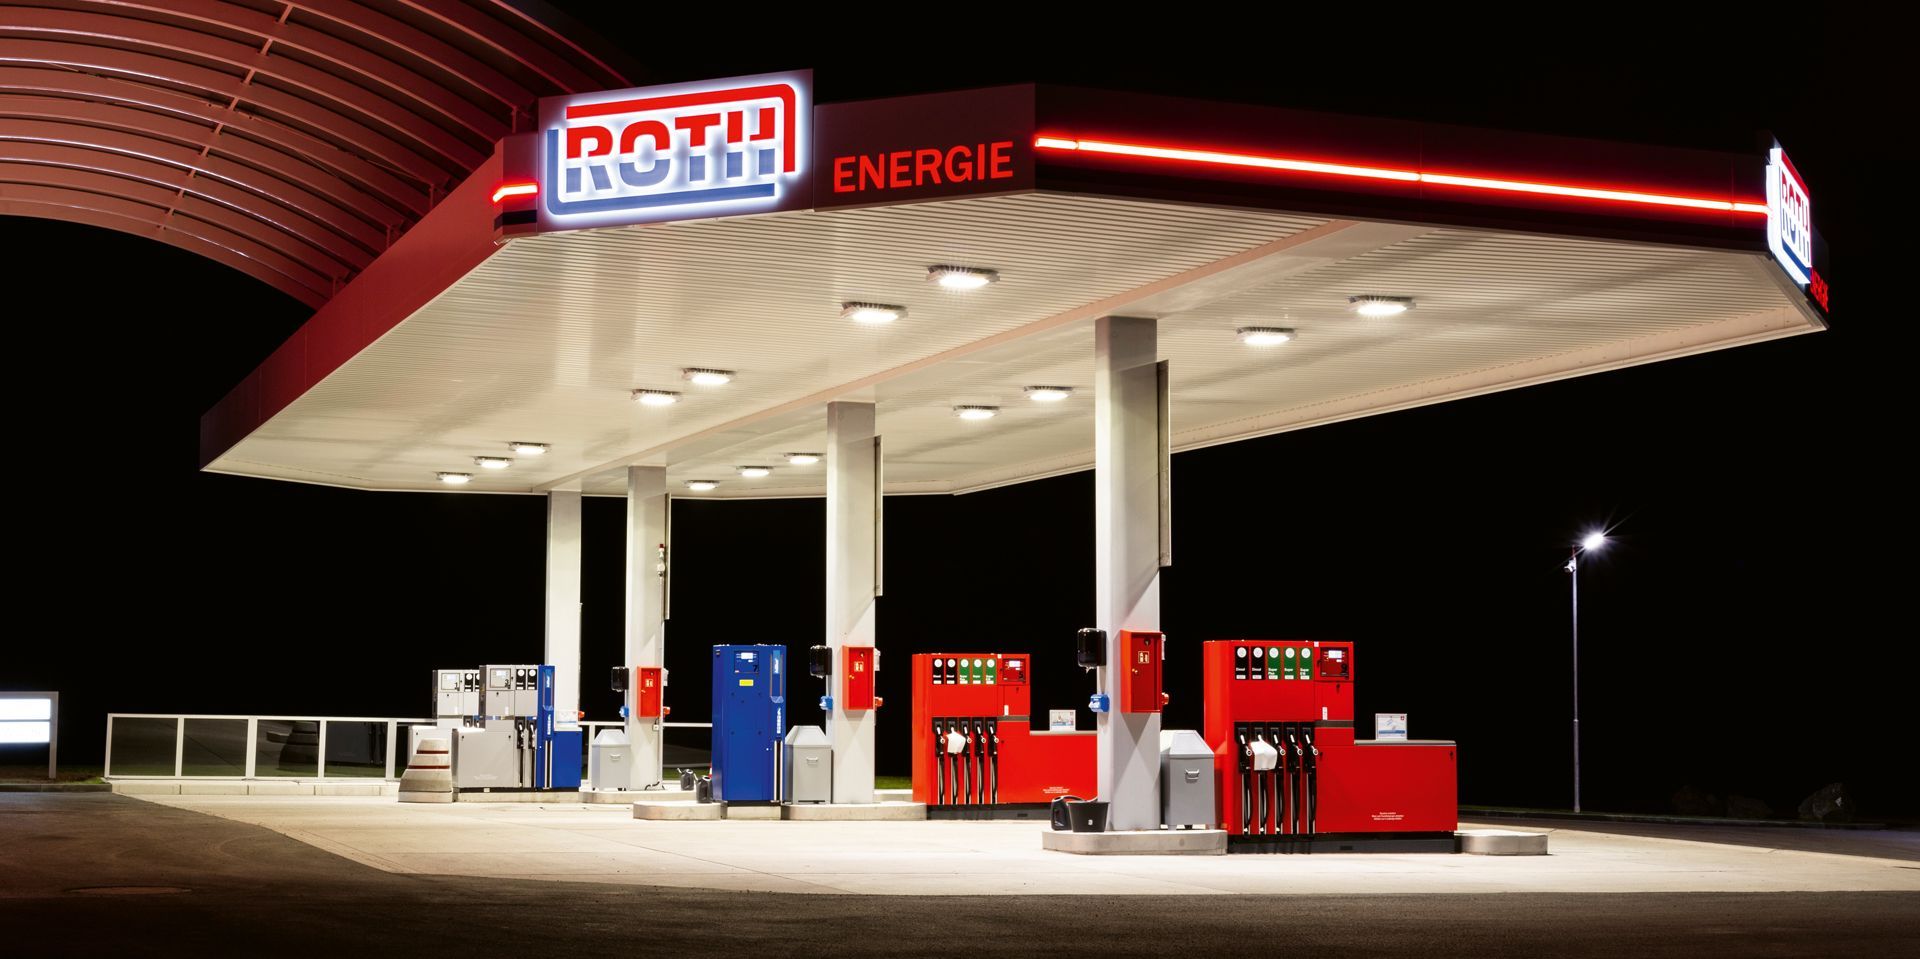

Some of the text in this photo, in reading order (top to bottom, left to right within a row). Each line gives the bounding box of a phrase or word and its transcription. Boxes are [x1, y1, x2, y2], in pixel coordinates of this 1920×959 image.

[565, 106, 776, 194] ROTH
[833, 140, 1014, 193] ENERGIE
[1781, 169, 1810, 263] ROTH
